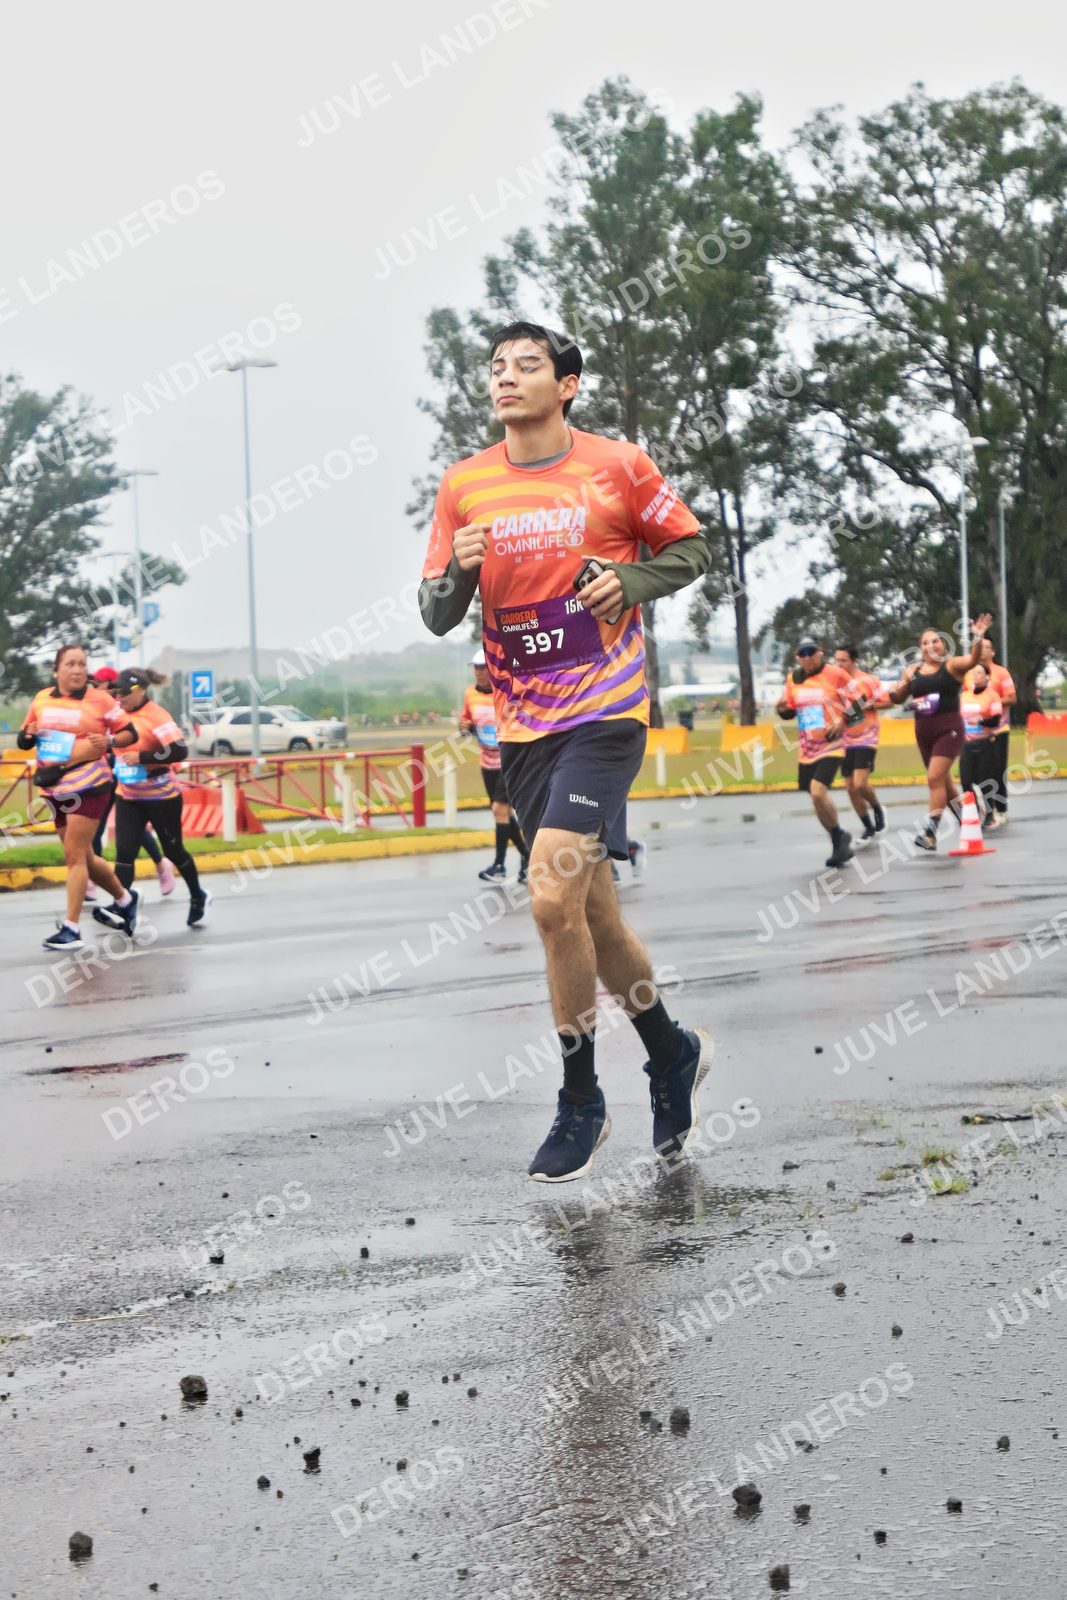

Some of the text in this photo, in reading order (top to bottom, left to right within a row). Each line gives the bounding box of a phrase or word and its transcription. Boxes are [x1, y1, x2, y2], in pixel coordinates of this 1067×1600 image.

[492, 506, 586, 540] CARRERA
[494, 534, 564, 556] OMNILIFE
[500, 609, 538, 625] CARRERA
[502, 622, 531, 633] OMNILIFE
[522, 628, 564, 655] 397
[569, 793, 599, 808] Wilson
